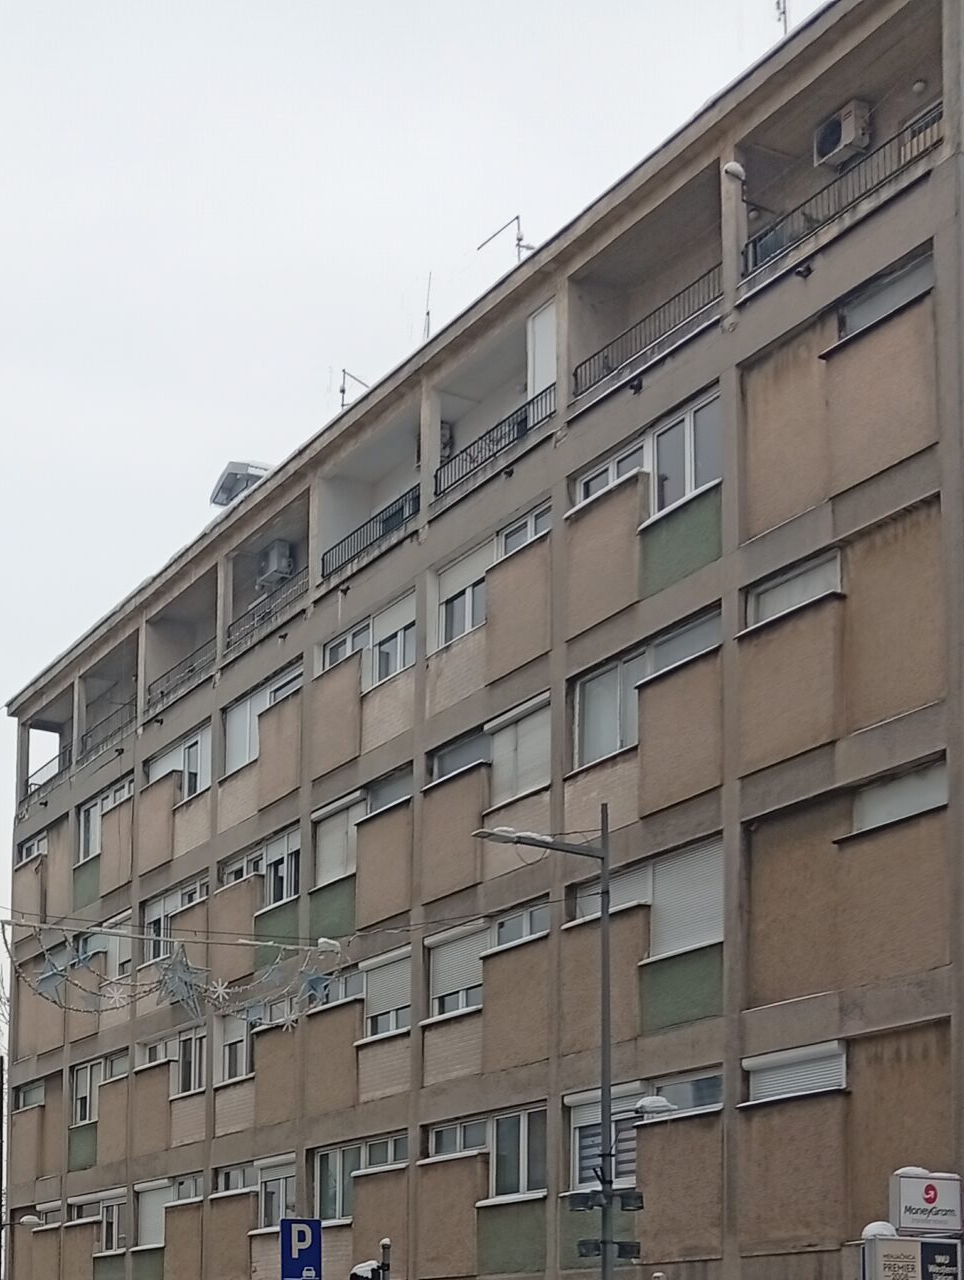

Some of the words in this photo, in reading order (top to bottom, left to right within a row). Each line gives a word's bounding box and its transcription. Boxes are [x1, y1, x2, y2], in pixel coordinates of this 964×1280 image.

[903, 1205, 957, 1218] MoneyGram
[291, 1223, 313, 1259] P
[883, 1263, 916, 1273] PREMIER
[928, 1264, 958, 1274] Western
